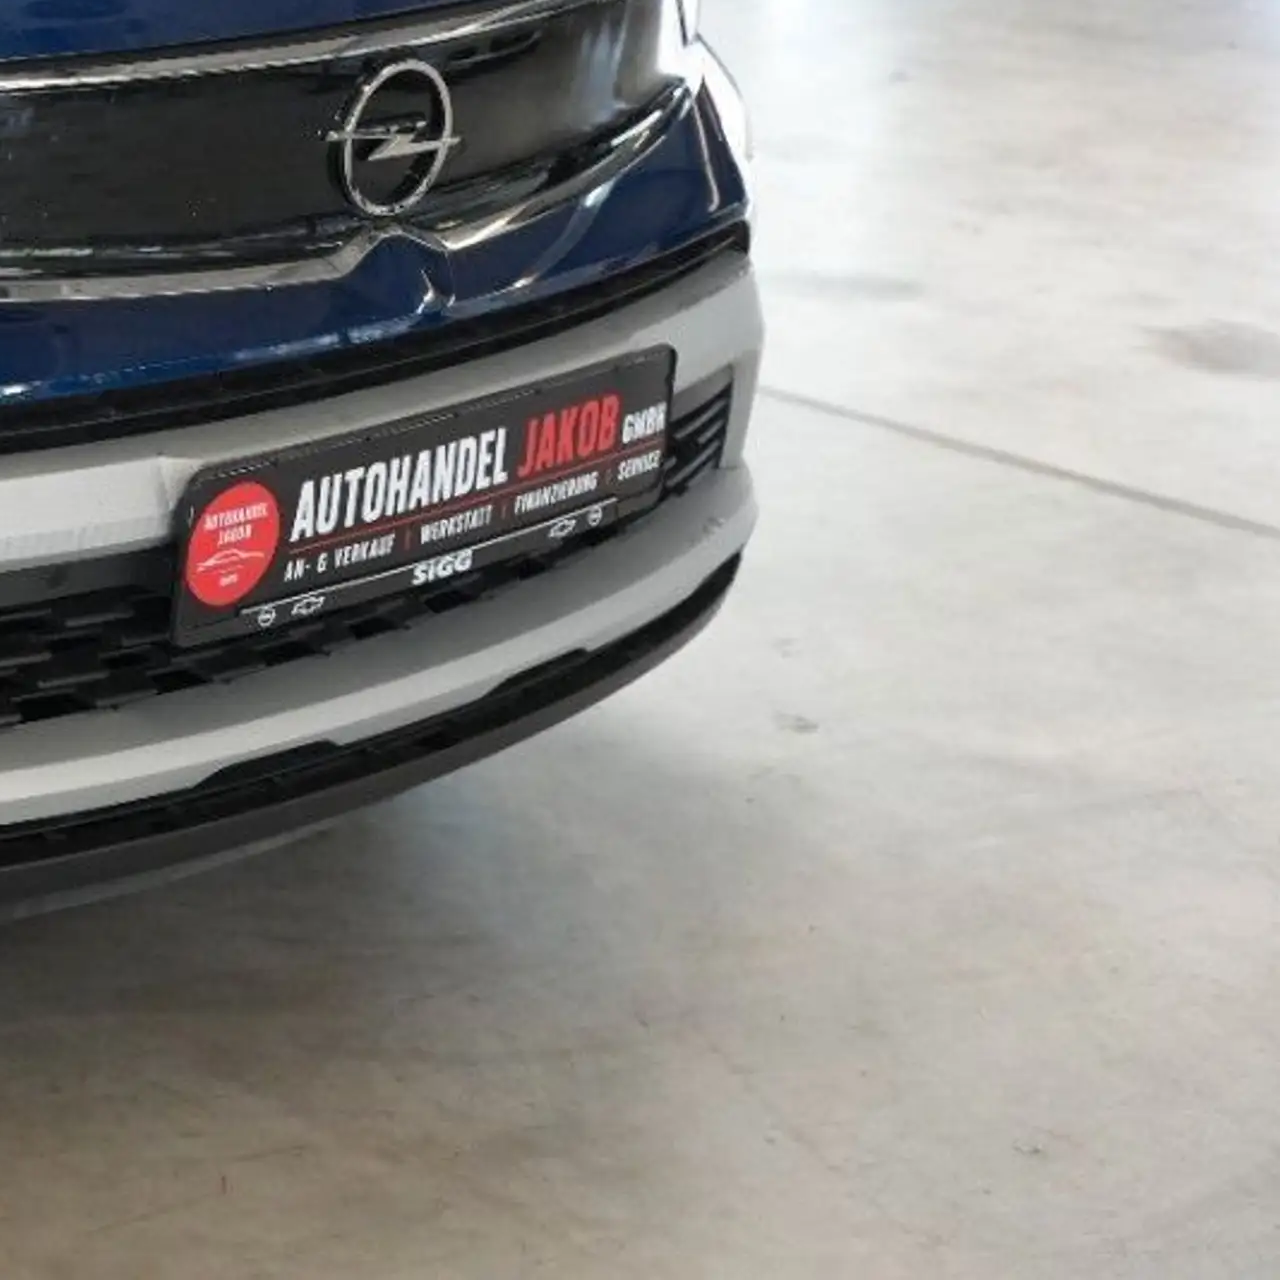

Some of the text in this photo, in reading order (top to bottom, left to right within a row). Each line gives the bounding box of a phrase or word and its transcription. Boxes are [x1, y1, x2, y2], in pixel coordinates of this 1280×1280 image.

[283, 558, 311, 583] AN-
[333, 533, 396, 569] VERKAUF
[419, 504, 493, 545] WERKSTATT
[514, 471, 600, 516] FINANZIERUNG
[289, 393, 668, 543] AUTOHANDEL JAKOB GMBH
